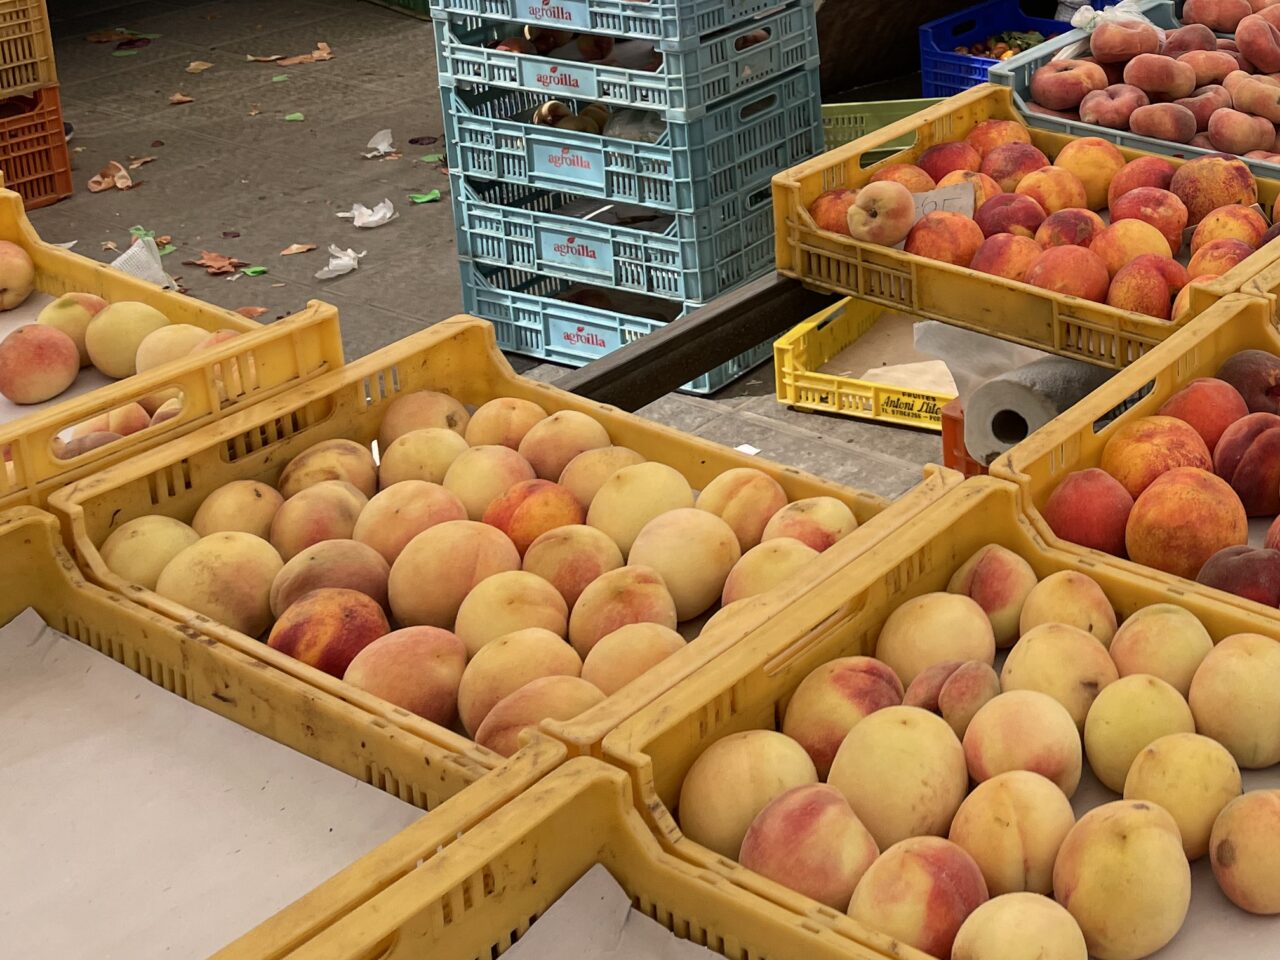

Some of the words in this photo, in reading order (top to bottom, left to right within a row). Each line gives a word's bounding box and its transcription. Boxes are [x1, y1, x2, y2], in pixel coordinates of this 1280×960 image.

[529, 3, 572, 22] agroilla
[536, 72, 580, 90] agroilla
[548, 152, 591, 171] agroilla
[554, 241, 597, 261] agroilla
[563, 330, 606, 349] agroilla
[881, 395, 915, 412] Antoni
[902, 392, 937, 402] FRUITES
